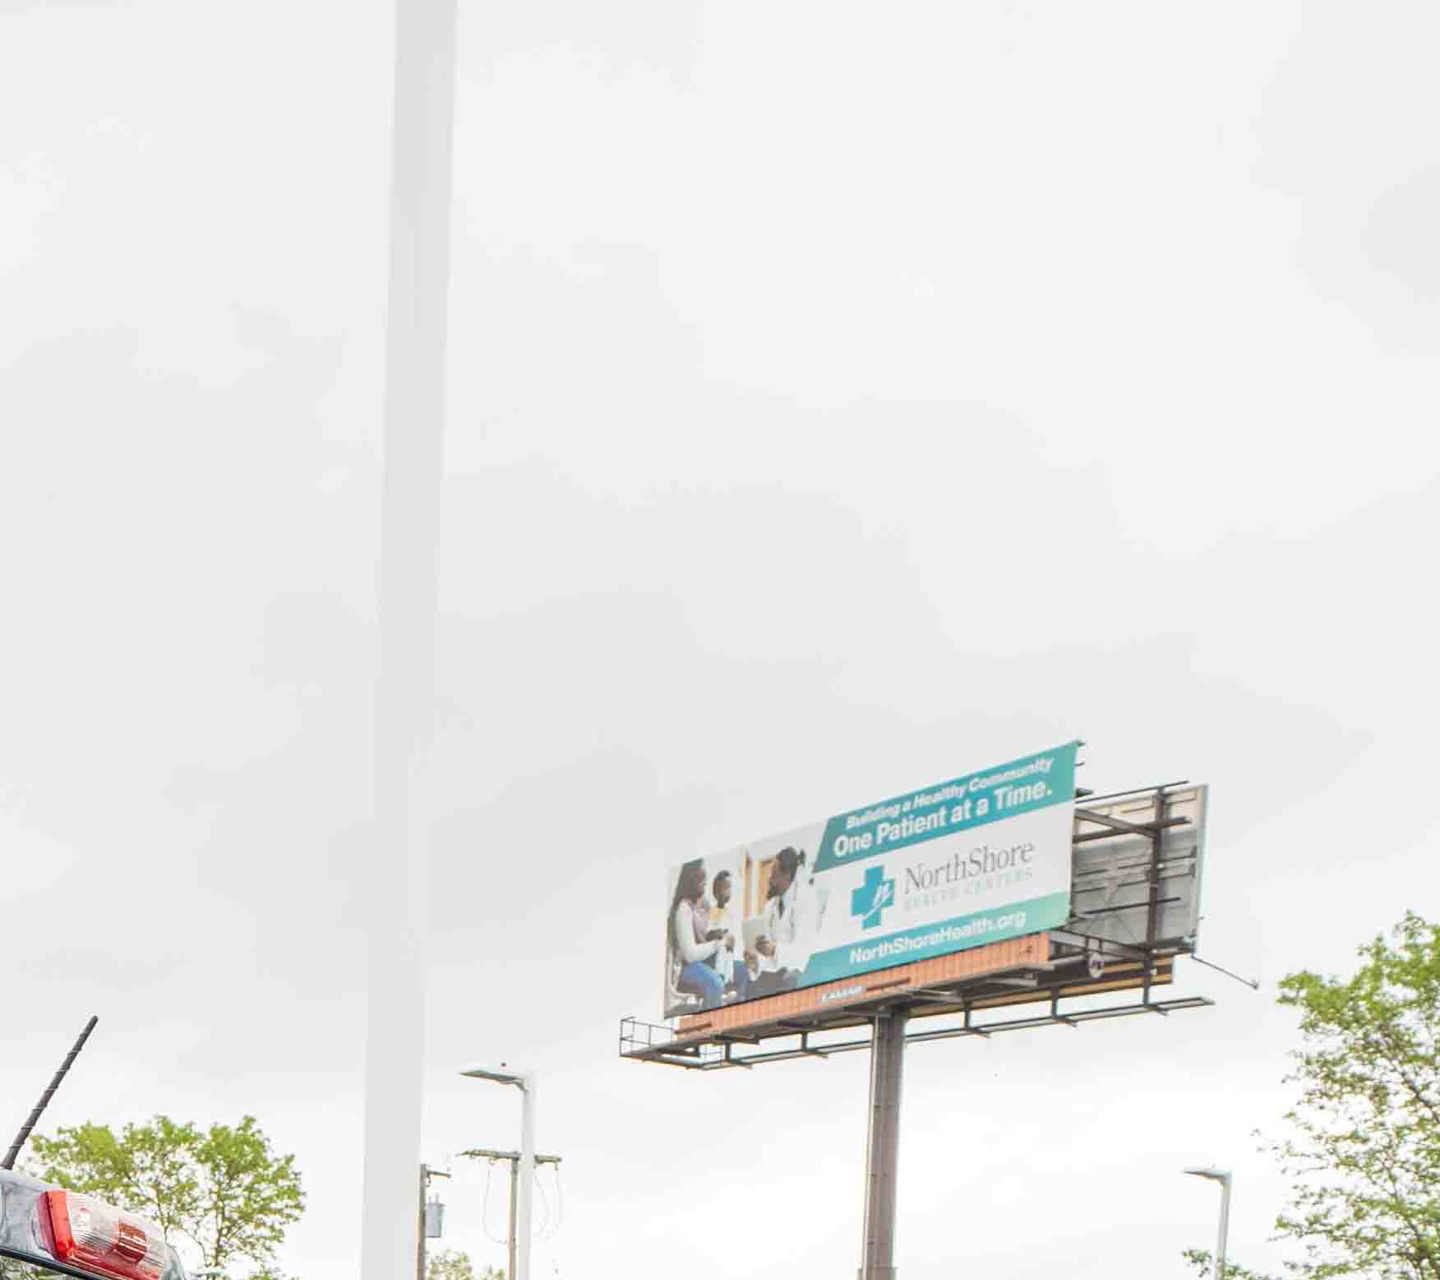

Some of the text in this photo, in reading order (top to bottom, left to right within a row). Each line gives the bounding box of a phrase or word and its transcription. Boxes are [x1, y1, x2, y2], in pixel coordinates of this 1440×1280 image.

[833, 779, 1054, 858] One Patient at a Time.
[846, 803, 900, 830] Building
[913, 783, 967, 809] Healthy
[969, 757, 1055, 792] Community
[903, 842, 1035, 896] NorthShore
[850, 911, 1028, 965] NorthShoreHealth.org
